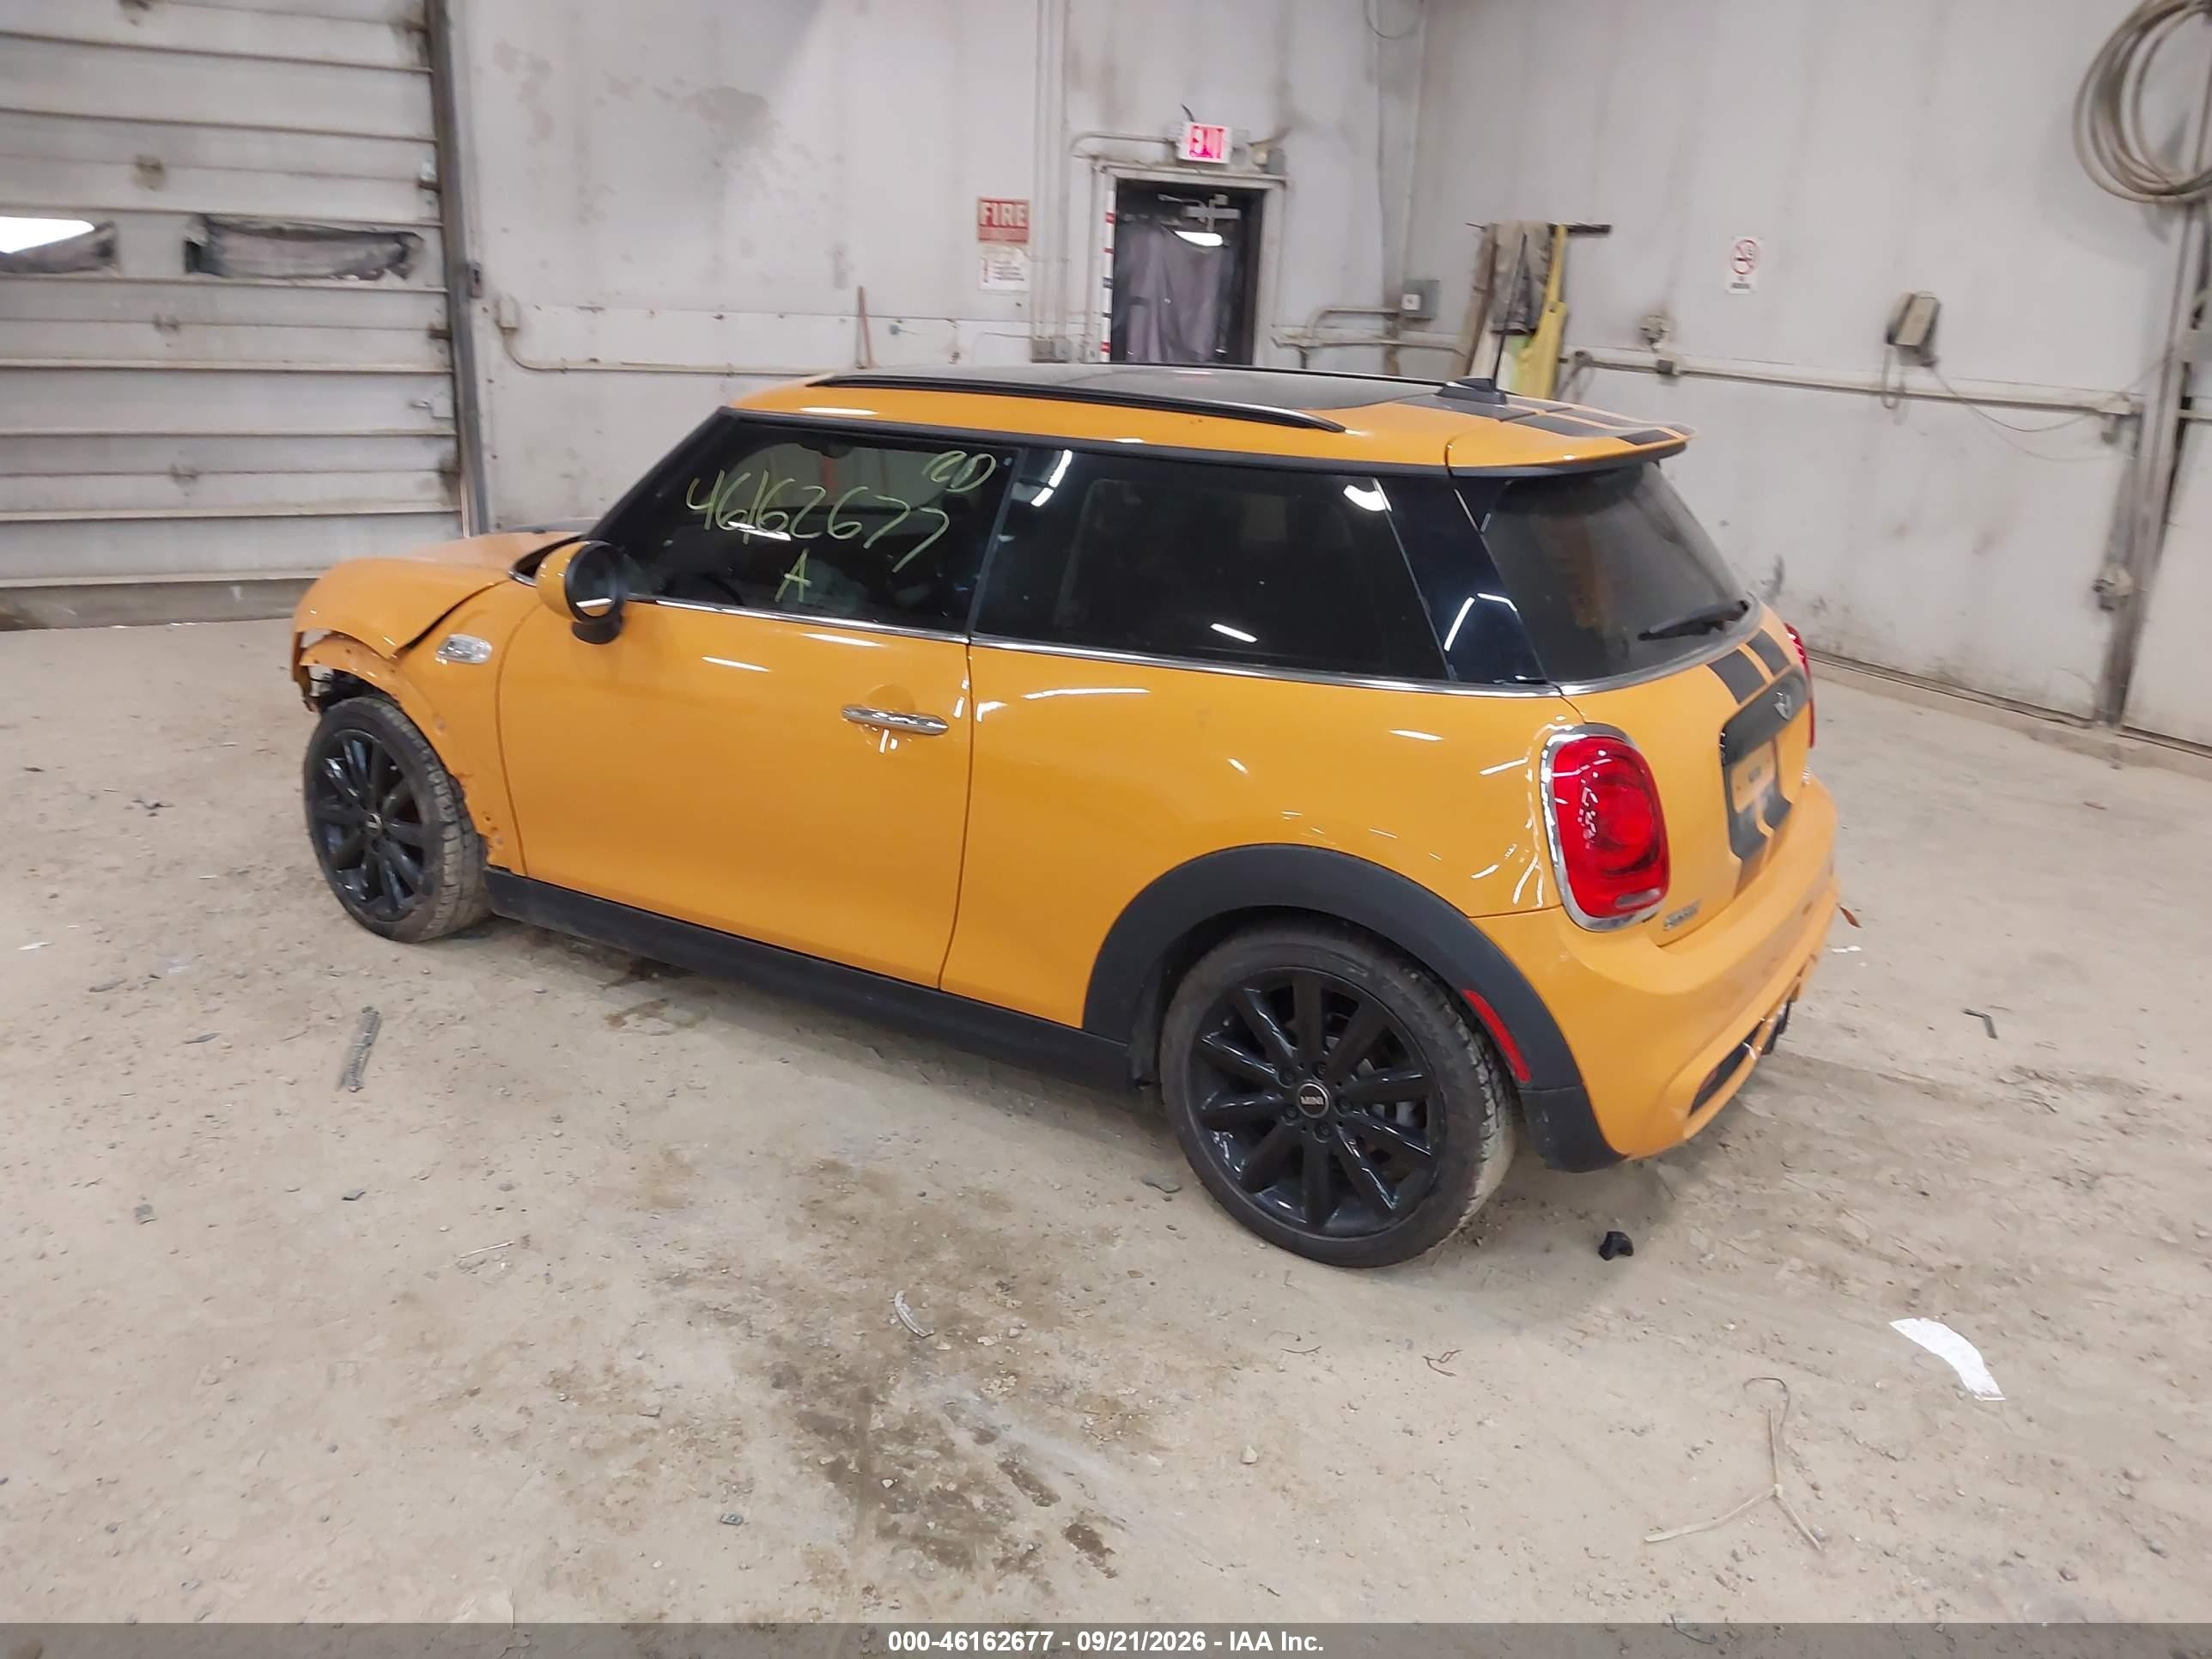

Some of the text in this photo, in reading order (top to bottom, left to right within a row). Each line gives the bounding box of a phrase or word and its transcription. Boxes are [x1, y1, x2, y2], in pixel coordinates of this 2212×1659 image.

[1190, 125, 1224, 159] EXIT
[979, 202, 1029, 228] FIRE
[686, 469, 951, 574] 46162677
[774, 548, 812, 603] A
[1299, 1095, 1324, 1105] MINI
